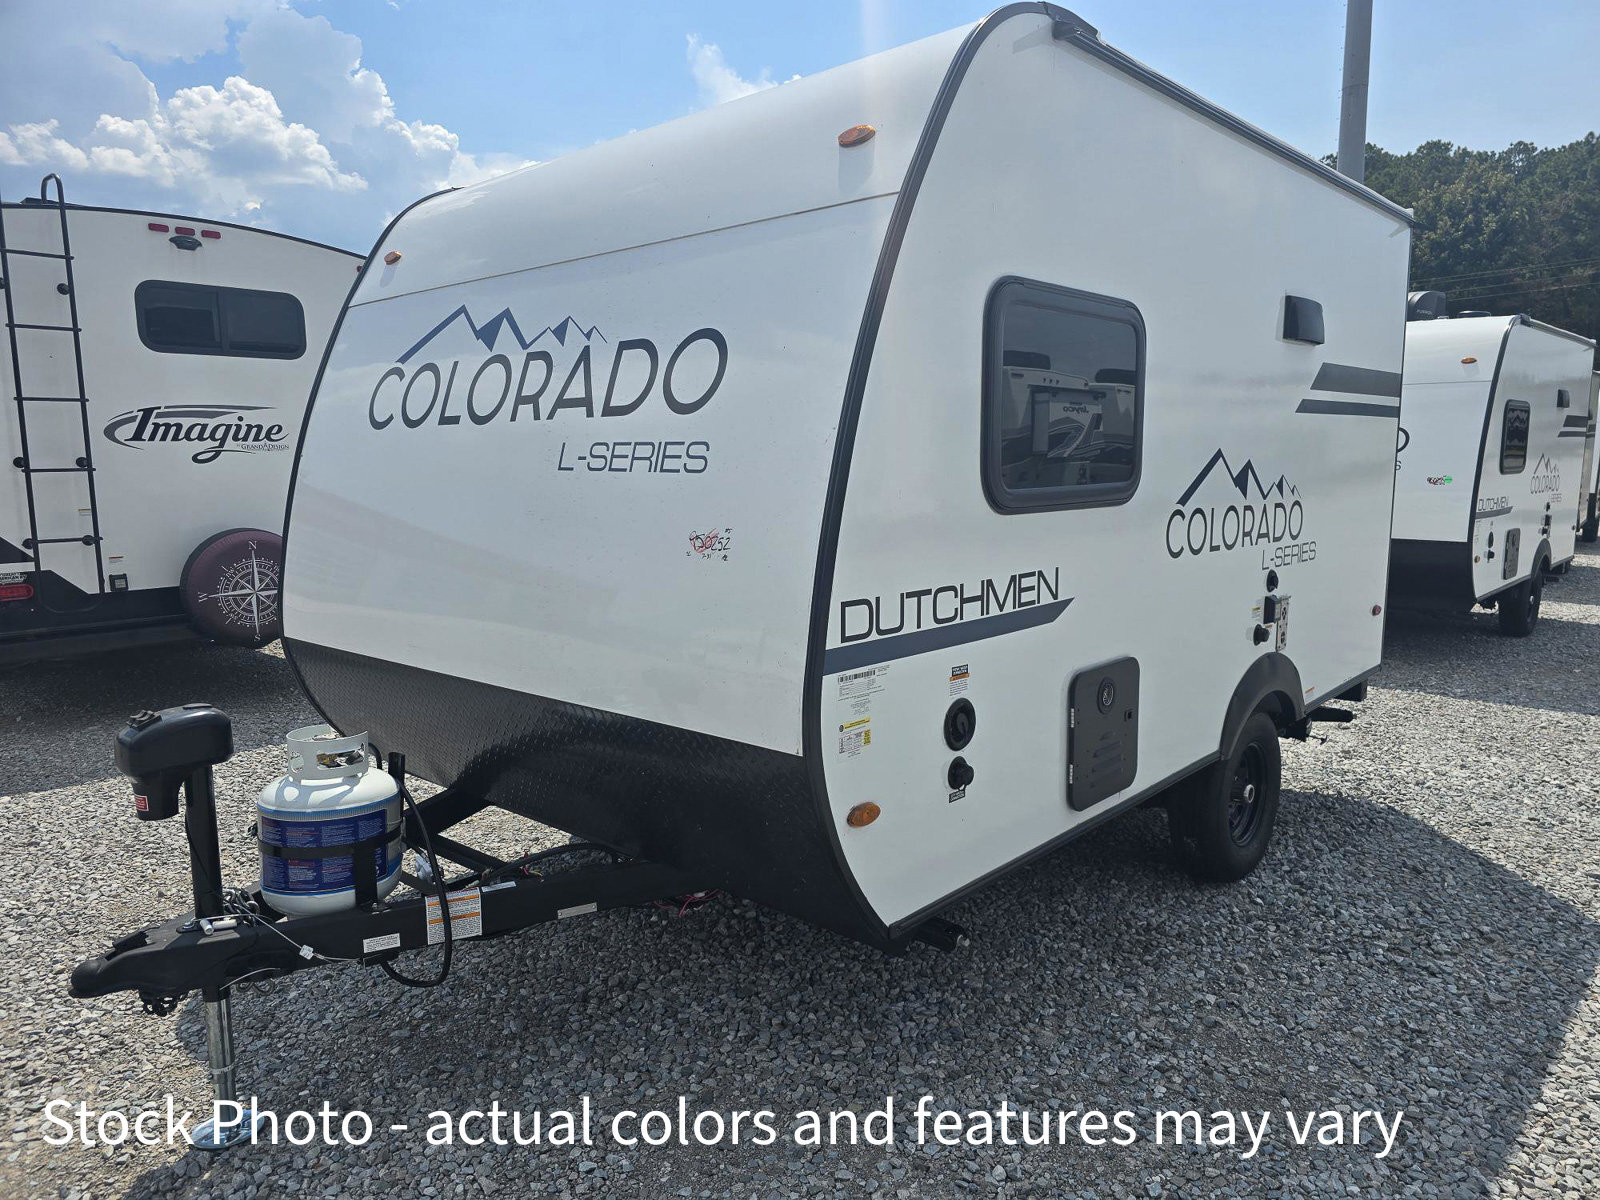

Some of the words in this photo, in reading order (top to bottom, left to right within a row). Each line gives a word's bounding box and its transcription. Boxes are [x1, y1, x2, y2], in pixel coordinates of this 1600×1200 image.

[368, 327, 728, 431] COLORADO
[129, 406, 289, 464] Imagine
[557, 441, 710, 474] L-SERIES
[248, 540, 258, 550] N
[1165, 500, 1304, 559] COLORADO
[1261, 541, 1317, 571] L-SERIES
[840, 566, 1061, 645] DUTCHMEN
[254, 634, 262, 642] S
